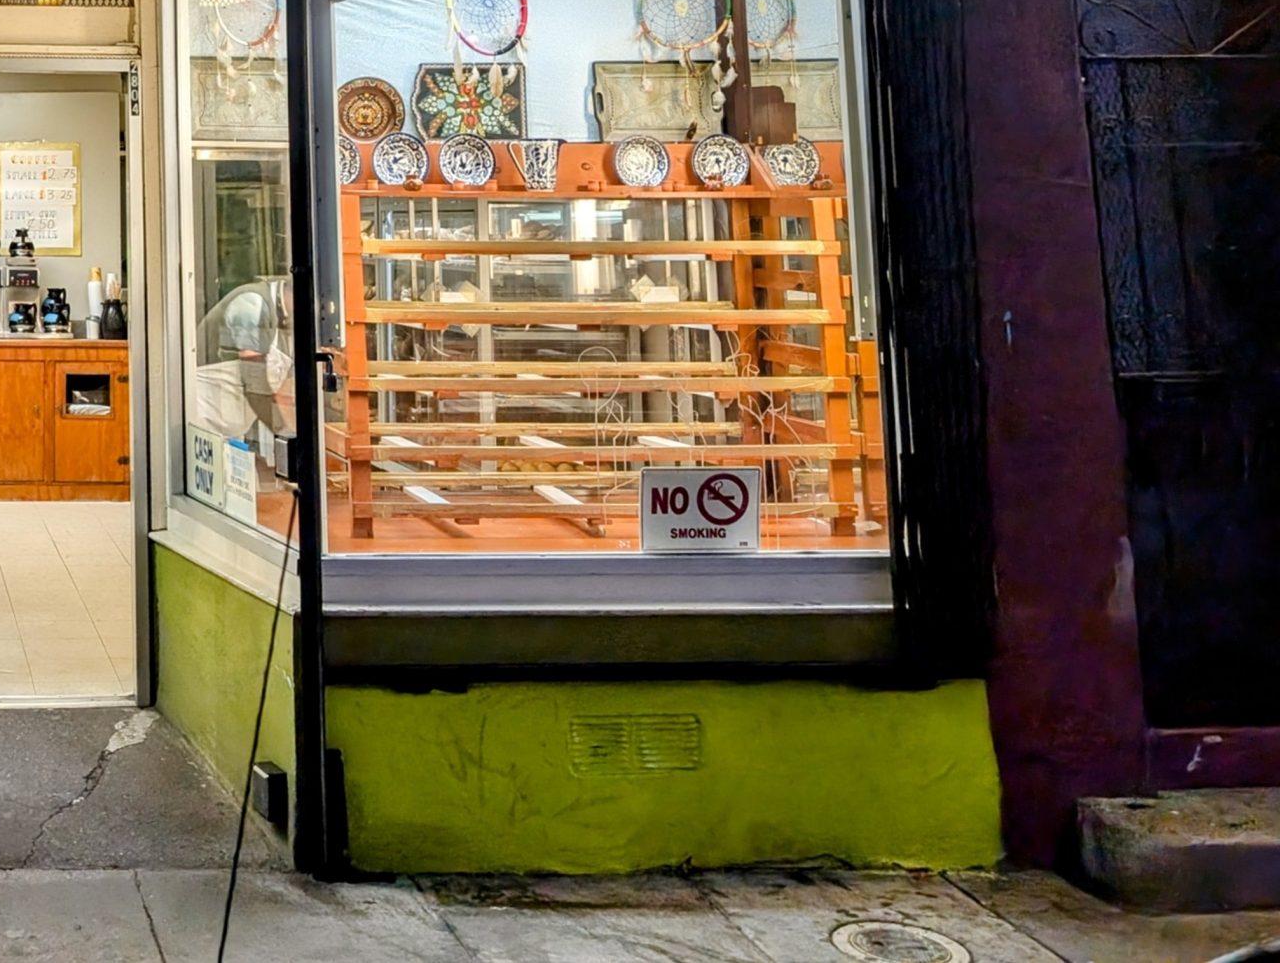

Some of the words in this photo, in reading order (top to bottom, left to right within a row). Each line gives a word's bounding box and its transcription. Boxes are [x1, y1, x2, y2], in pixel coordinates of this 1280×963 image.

[130, 60, 138, 115] 2804
[194, 435, 213, 467] CASH
[194, 464, 214, 496] ONLY
[651, 486, 689, 515] NO
[670, 528, 727, 539] SMOKING
